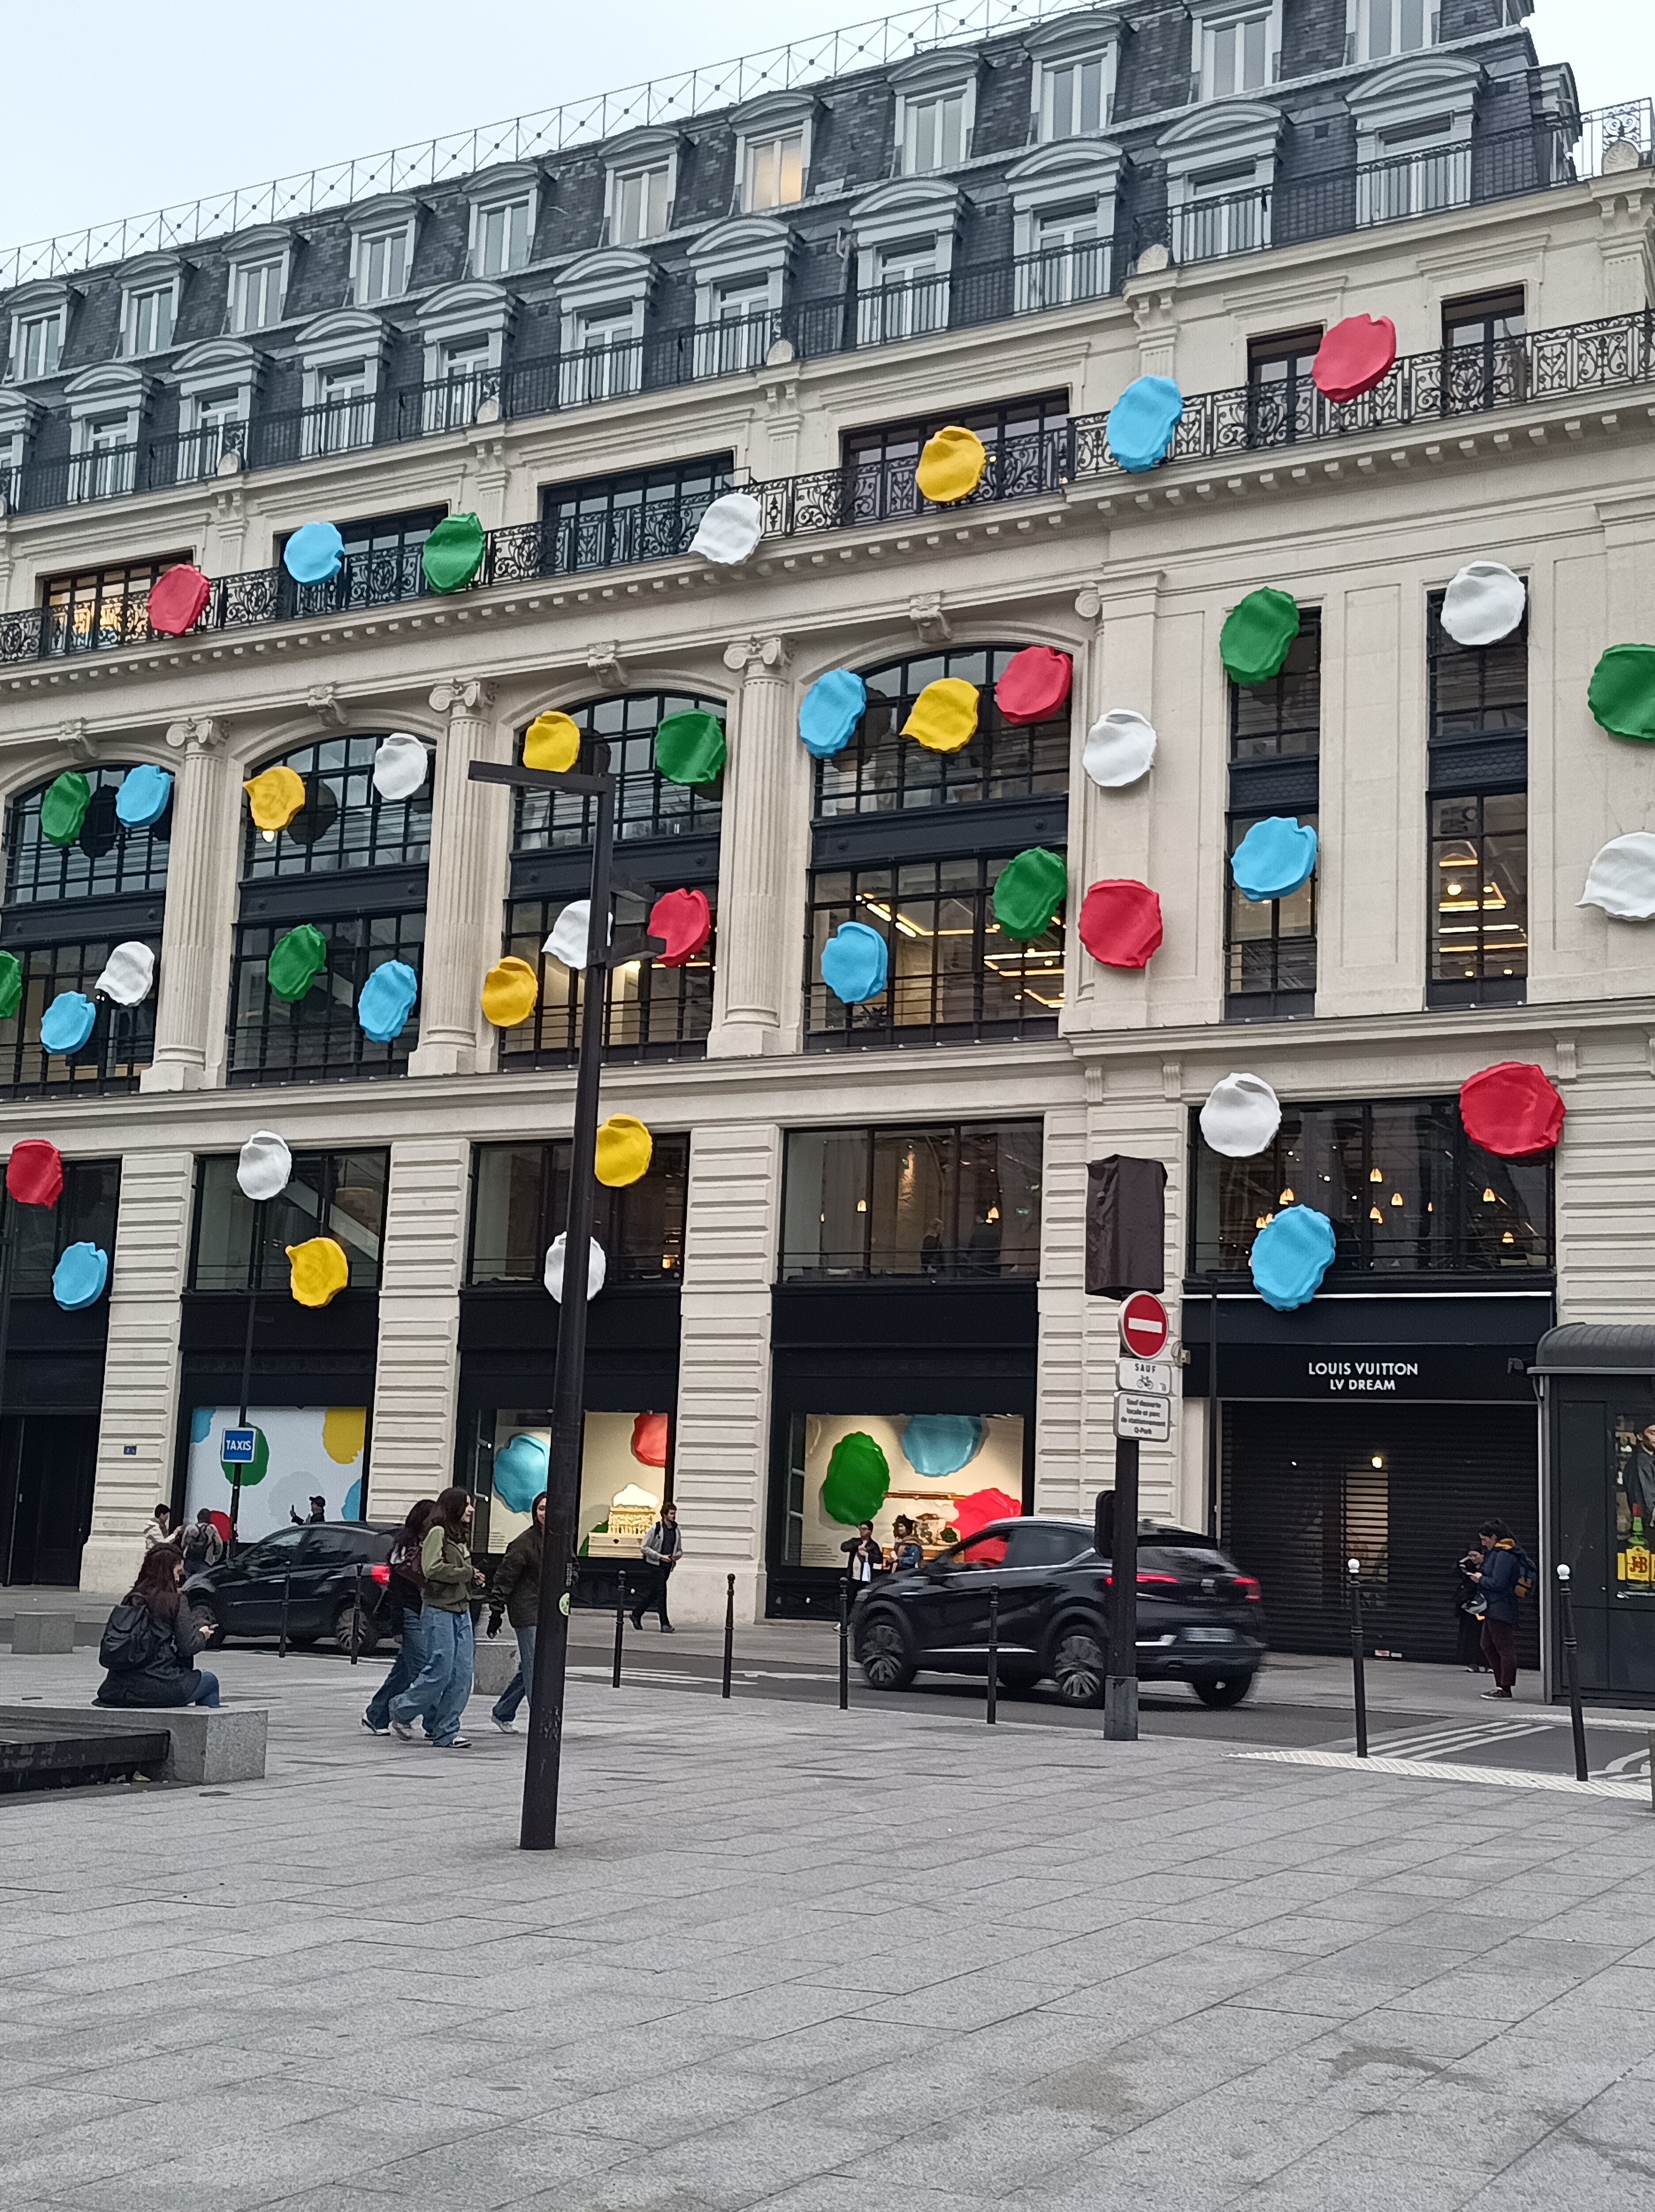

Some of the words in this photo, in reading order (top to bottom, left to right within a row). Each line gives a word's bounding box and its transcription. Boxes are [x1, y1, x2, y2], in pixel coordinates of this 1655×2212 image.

[1134, 1363, 1156, 1373] SAUF
[1308, 1362, 1351, 1375] LOUIS
[1355, 1363, 1418, 1375] VUITTON
[1330, 1379, 1345, 1390] LV
[1349, 1379, 1396, 1391] DREAM
[226, 1439, 252, 1451] TAXIS
